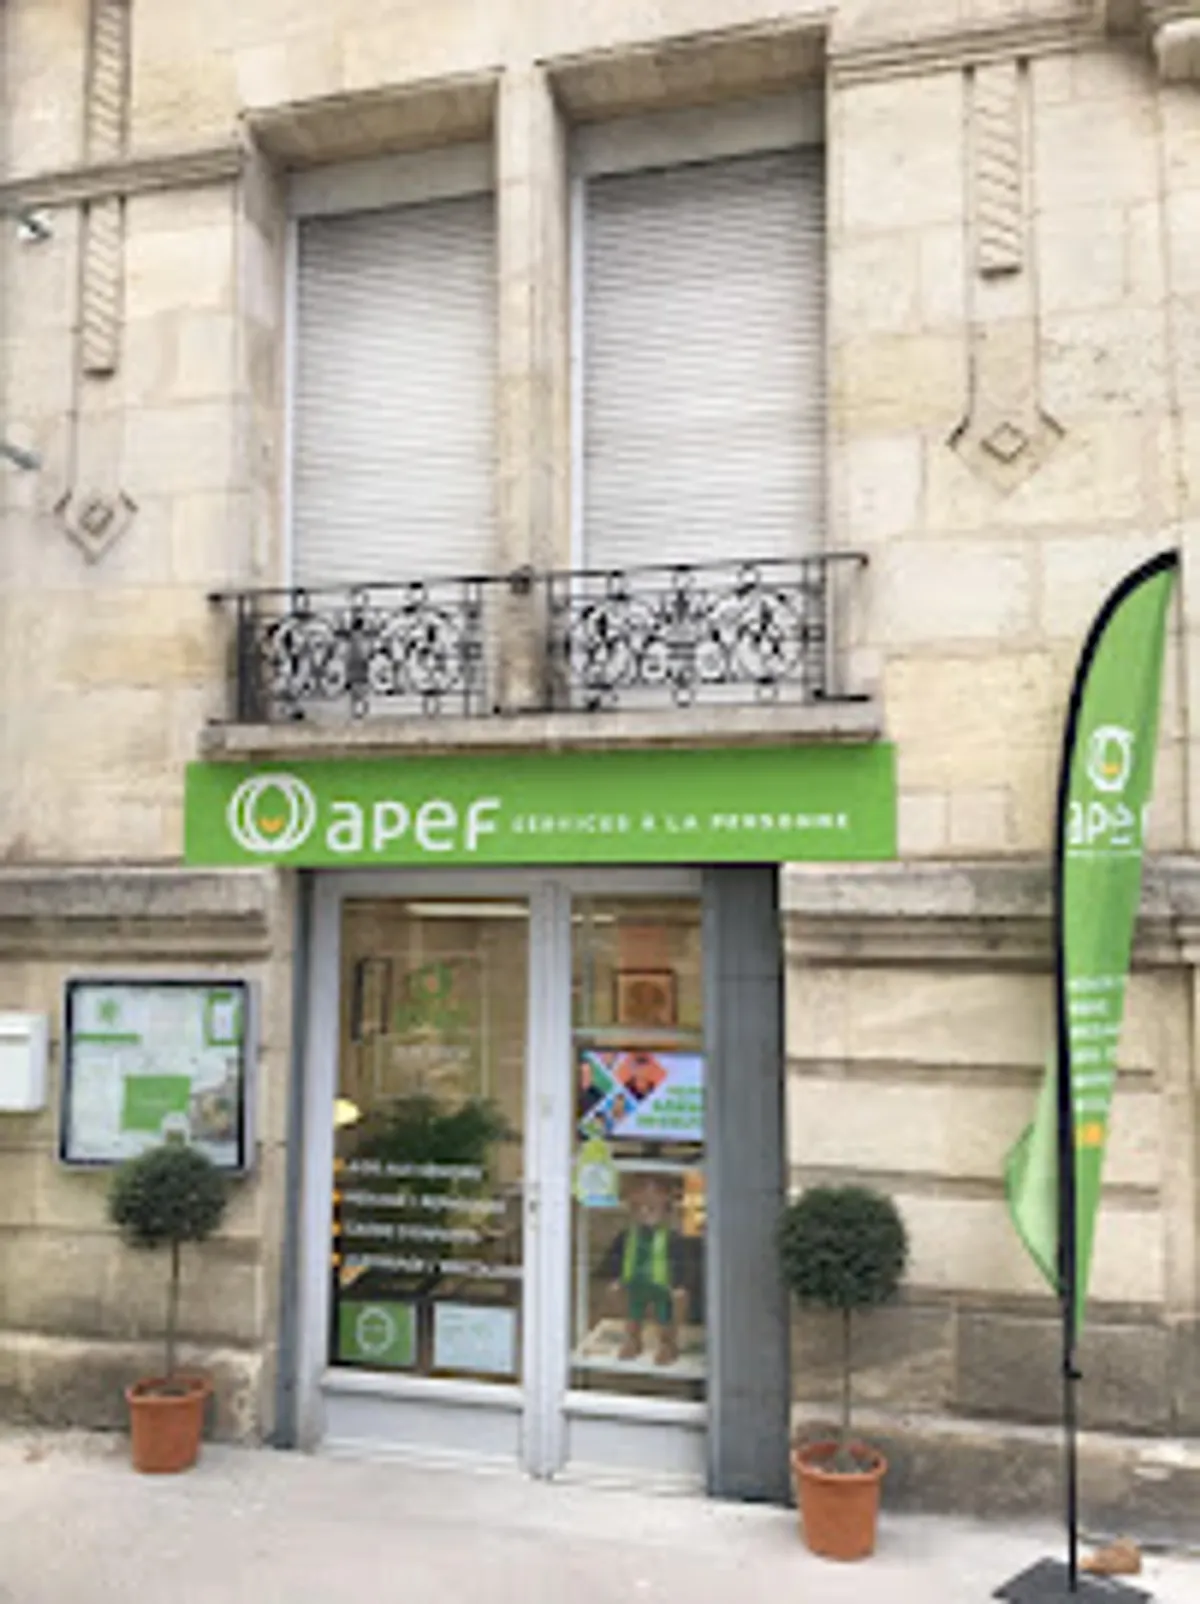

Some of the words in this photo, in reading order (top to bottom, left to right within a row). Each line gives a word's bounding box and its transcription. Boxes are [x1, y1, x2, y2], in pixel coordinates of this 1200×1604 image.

[326, 797, 501, 852] apef
[664, 812, 698, 834] LA
[711, 811, 848, 830] PERSONNE
